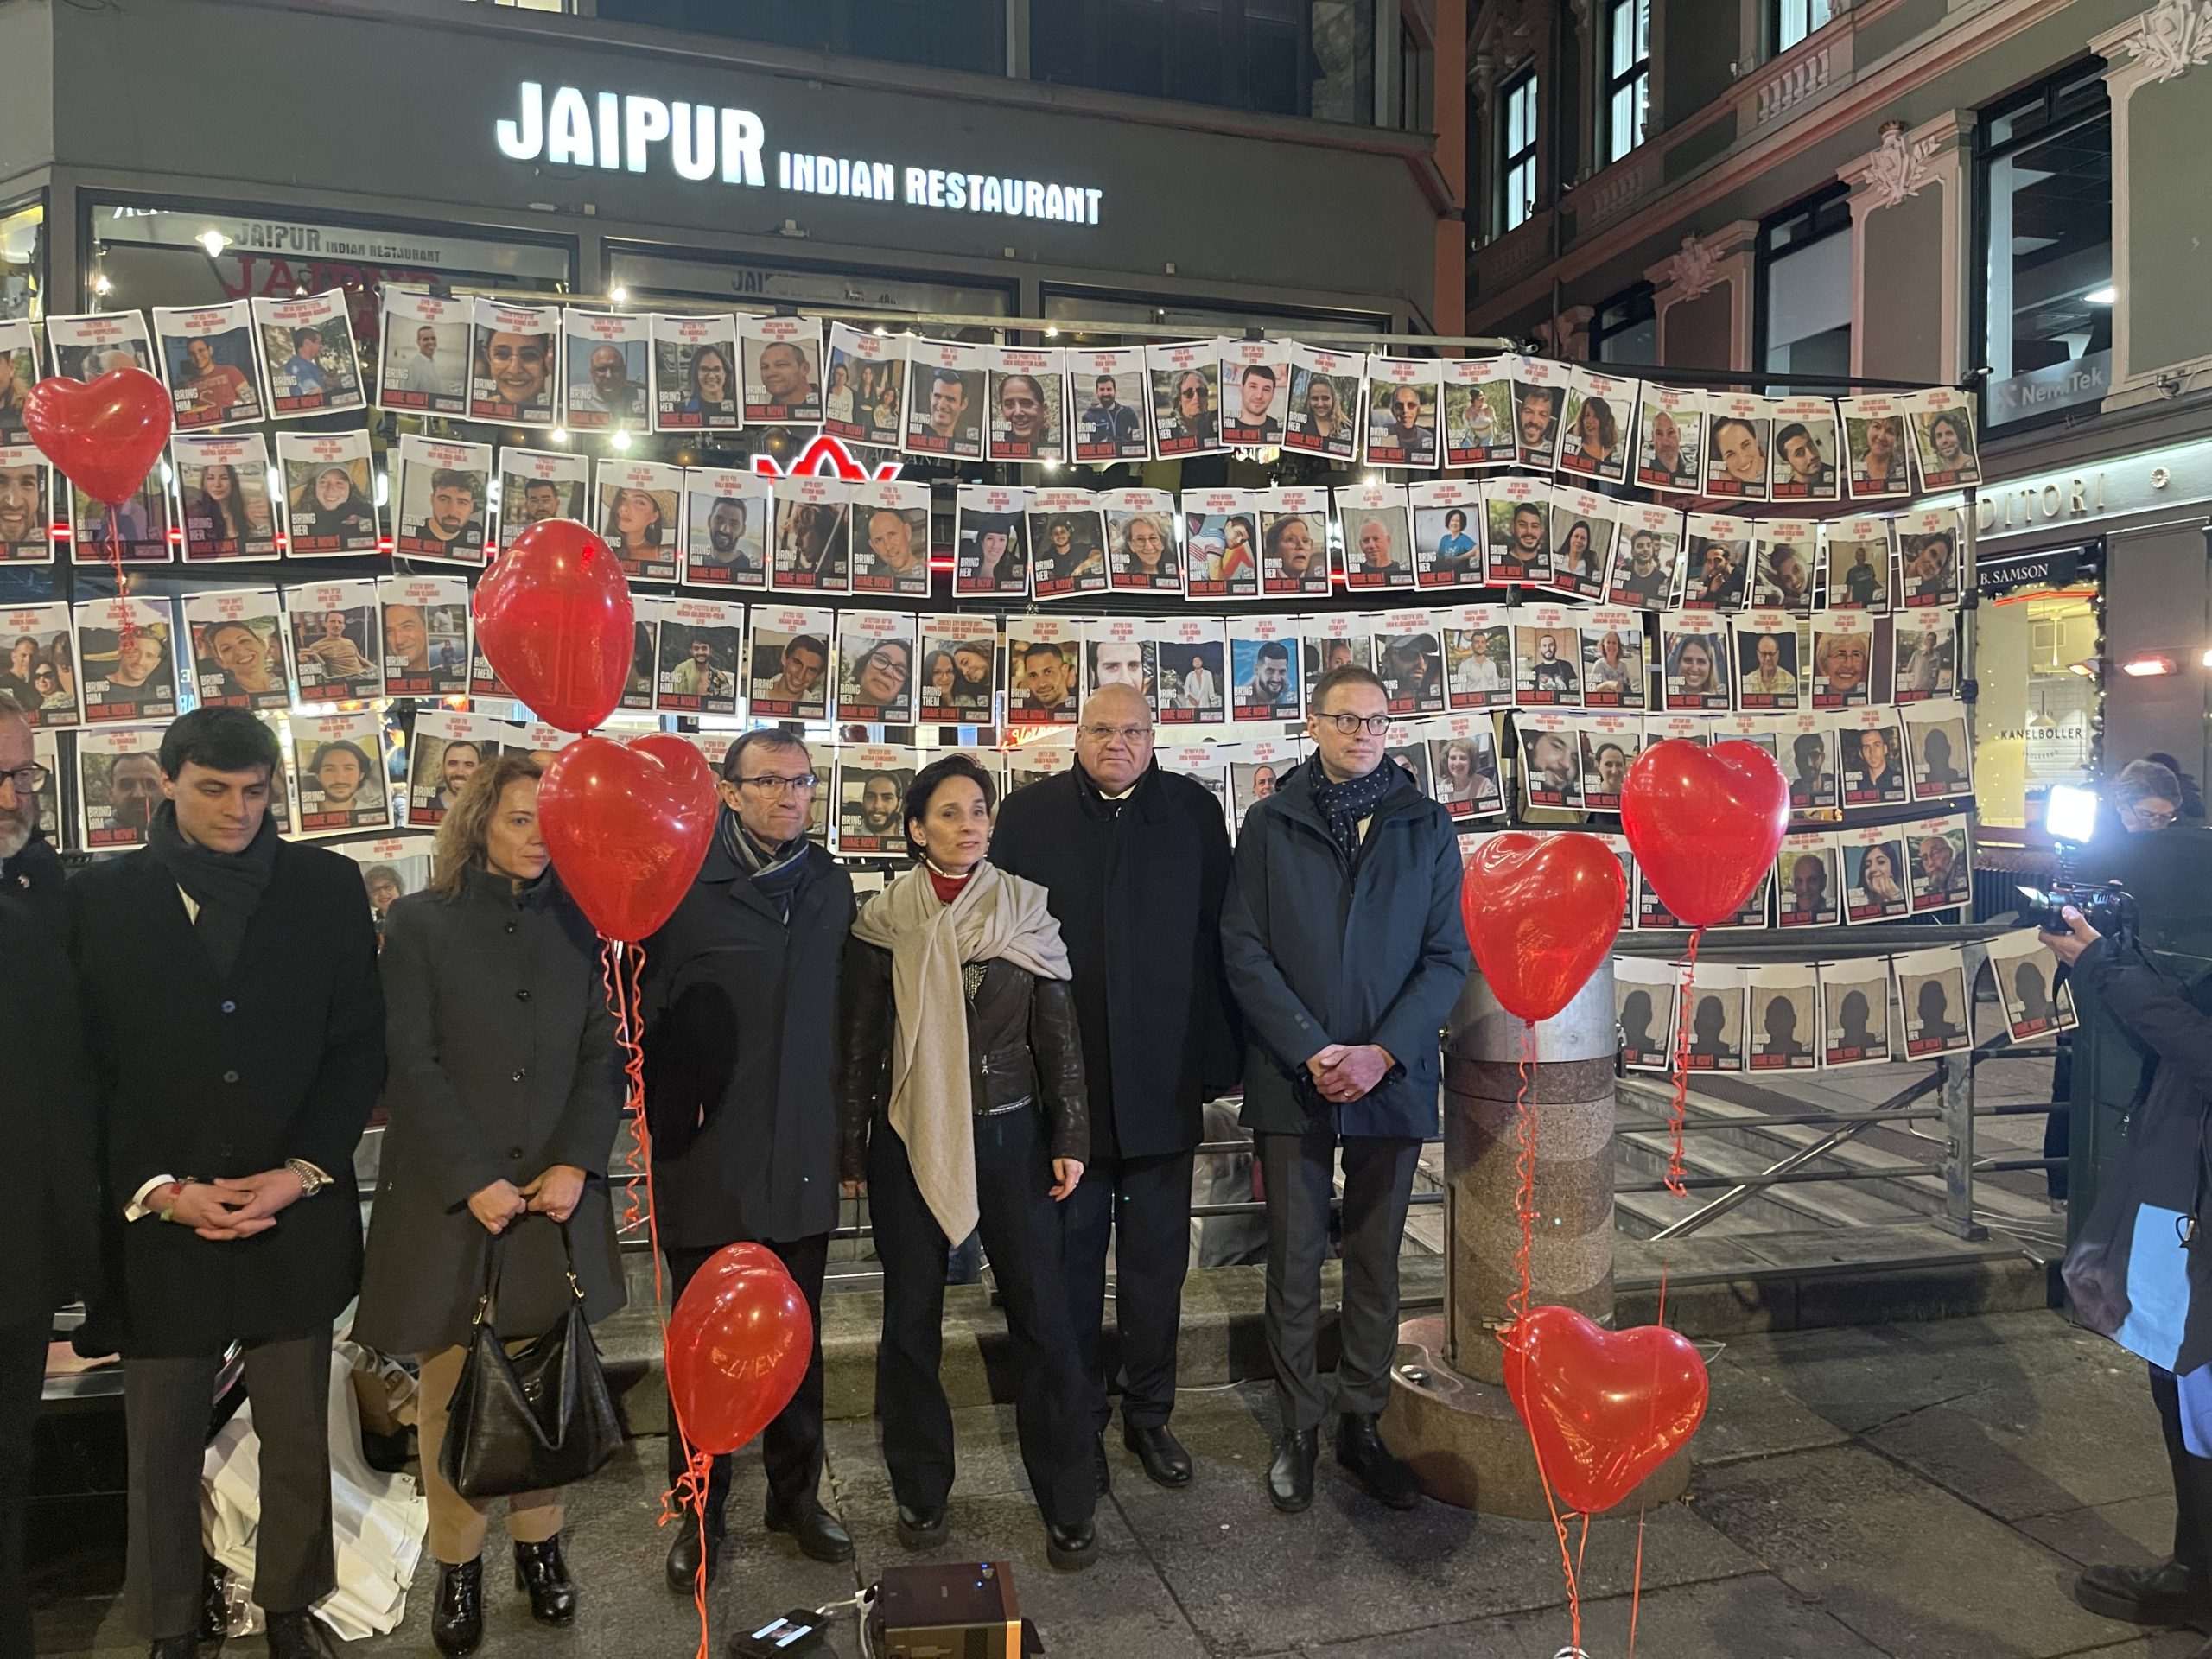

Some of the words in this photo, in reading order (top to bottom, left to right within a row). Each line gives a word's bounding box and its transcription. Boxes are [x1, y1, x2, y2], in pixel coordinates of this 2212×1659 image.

[496, 81, 766, 188] JAIPUR
[779, 151, 894, 201] INDIAN
[906, 167, 1103, 225] RESTAURANT
[235, 222, 321, 251] JAIPUR
[326, 241, 365, 257] INDIAN
[370, 245, 441, 262] RESTAURANT
[474, 378, 497, 391] BRING
[659, 391, 681, 402] BRING
[660, 402, 674, 412] HER
[910, 413, 930, 424] BRING
[1289, 411, 1307, 423] BRING
[909, 423, 922, 434] HIM
[993, 421, 1012, 432] BRING
[1077, 423, 1096, 433] BRING
[1157, 418, 1177, 429] BRING
[1288, 422, 1300, 432] HER
[992, 431, 1005, 442] HER
[1078, 433, 1090, 442] HIM
[1159, 428, 1171, 439] HER
[605, 536, 621, 548] RING
[690, 545, 710, 556] BRING
[776, 550, 797, 560] BRING
[690, 555, 702, 565] HIM
[855, 554, 875, 564] BRING
[960, 557, 979, 568] BRING
[1111, 554, 1130, 564] BRING
[1265, 558, 1282, 569] BRING
[776, 561, 789, 571] HIM
[855, 564, 867, 575] HIM
[1035, 560, 1054, 571] BRING
[1112, 563, 1124, 573] HER
[1349, 563, 1361, 573] HIM
[959, 568, 971, 577] HER
[1036, 570, 1049, 581] HER
[1265, 569, 1276, 578] HER
[1980, 572, 1990, 586] B.
[1993, 563, 2049, 583] SAMSON
[386, 656, 409, 666] BRING
[661, 672, 682, 683] BRING
[660, 683, 673, 693] HIM
[753, 678, 773, 689] BRING
[1383, 680, 1398, 690] RING
[841, 684, 860, 695] BRING
[923, 686, 942, 696] BRING
[1011, 689, 1030, 698] BRING
[840, 695, 853, 705] HER
[923, 696, 939, 706] THEM
[1011, 699, 1023, 708] HIM
[1235, 696, 1246, 706] HIM
[2001, 728, 2082, 740] KANELBOLLER
[842, 815, 861, 826] BRING
[842, 826, 854, 835] HIM
